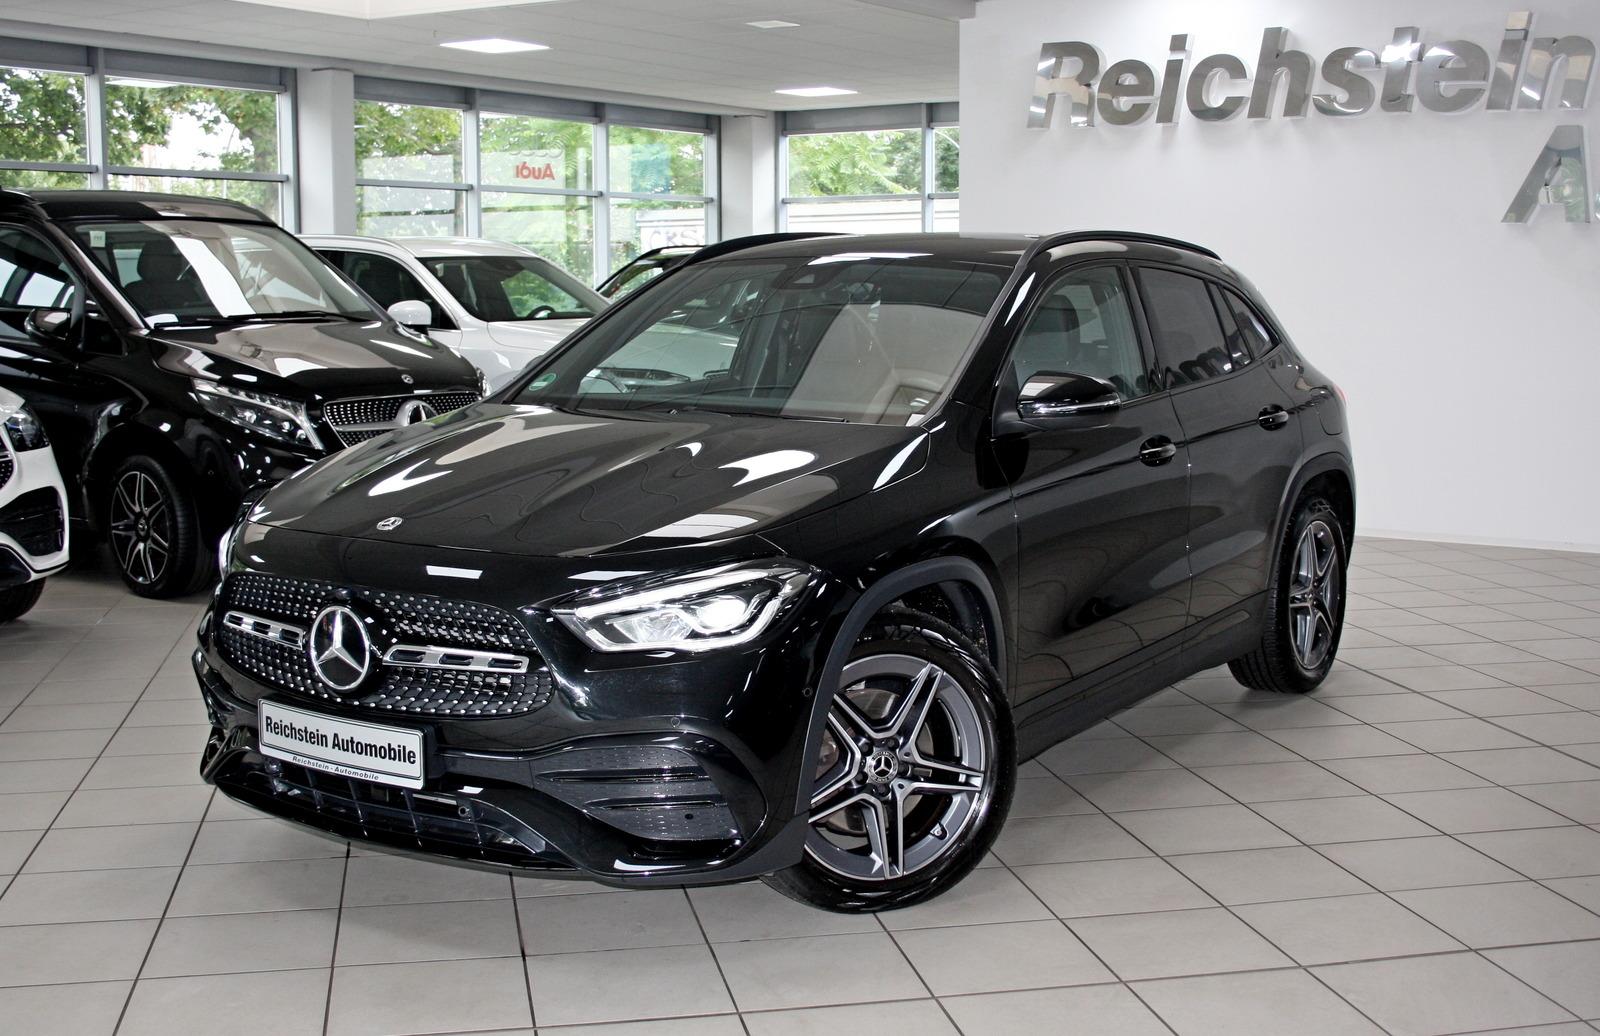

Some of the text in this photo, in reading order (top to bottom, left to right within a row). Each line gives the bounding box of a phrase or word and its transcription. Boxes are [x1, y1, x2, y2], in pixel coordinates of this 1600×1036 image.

[1027, 11, 1598, 129] Reichstein
[1501, 124, 1600, 223] A
[265, 715, 417, 765] Reichstein Automobile
[292, 755, 330, 770] Reichstein
[334, 766, 379, 781] Automobile
